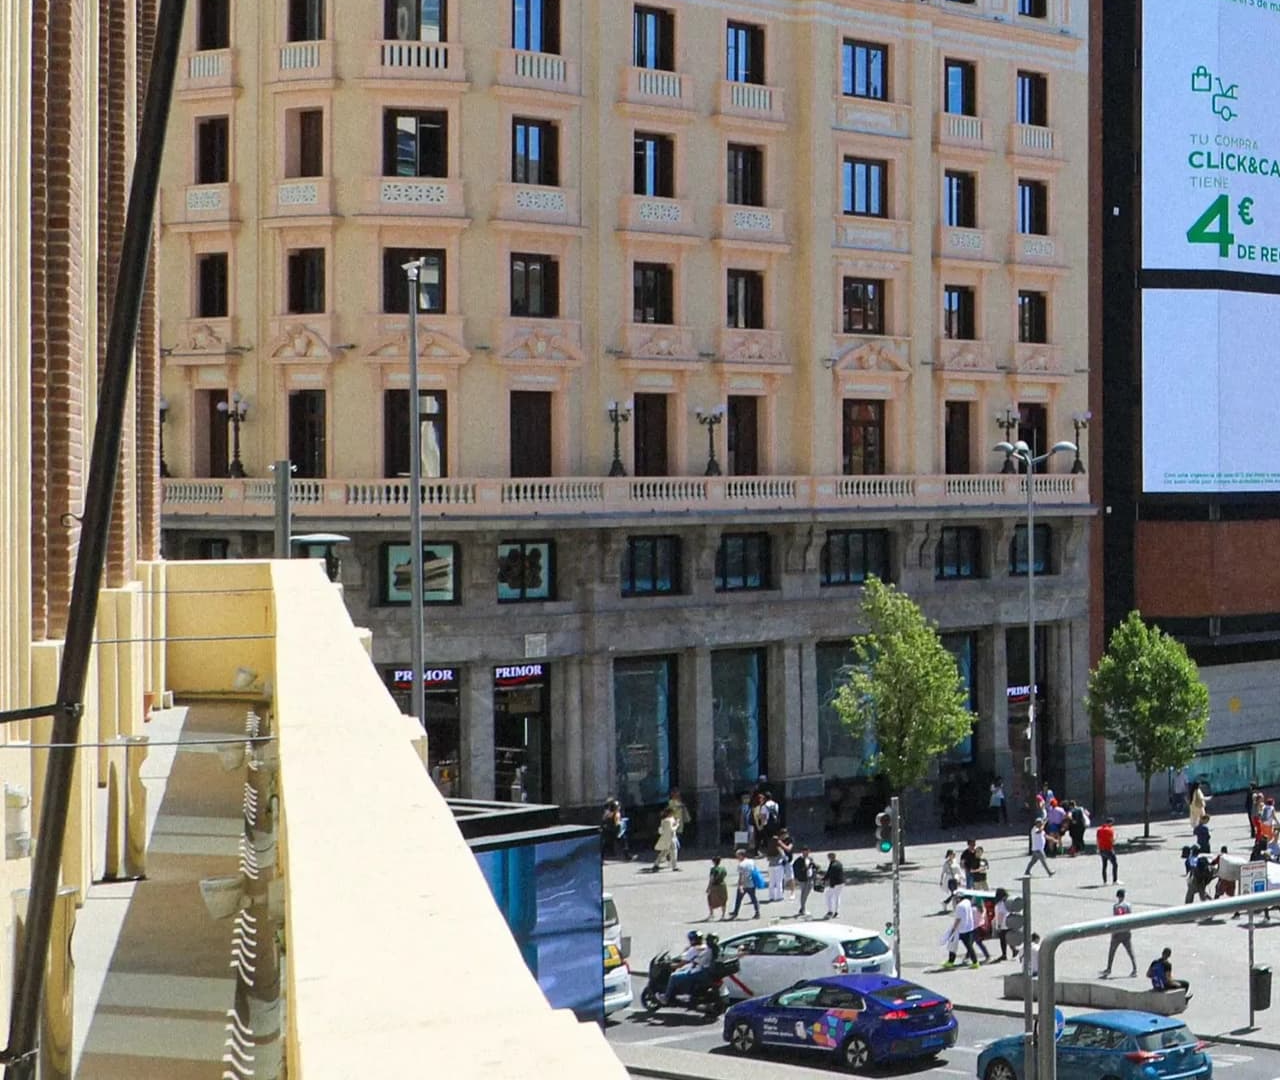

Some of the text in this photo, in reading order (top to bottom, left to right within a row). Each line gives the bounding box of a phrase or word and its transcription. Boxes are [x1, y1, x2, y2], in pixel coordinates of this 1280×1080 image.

[1189, 134, 1259, 150] TU COMPRA
[1189, 175, 1230, 189] TIENE
[1186, 193, 1255, 258] 4 €
[1237, 244, 1256, 261] DE
[394, 670, 453, 681] PRMOR
[495, 664, 542, 678] PRIMOR
